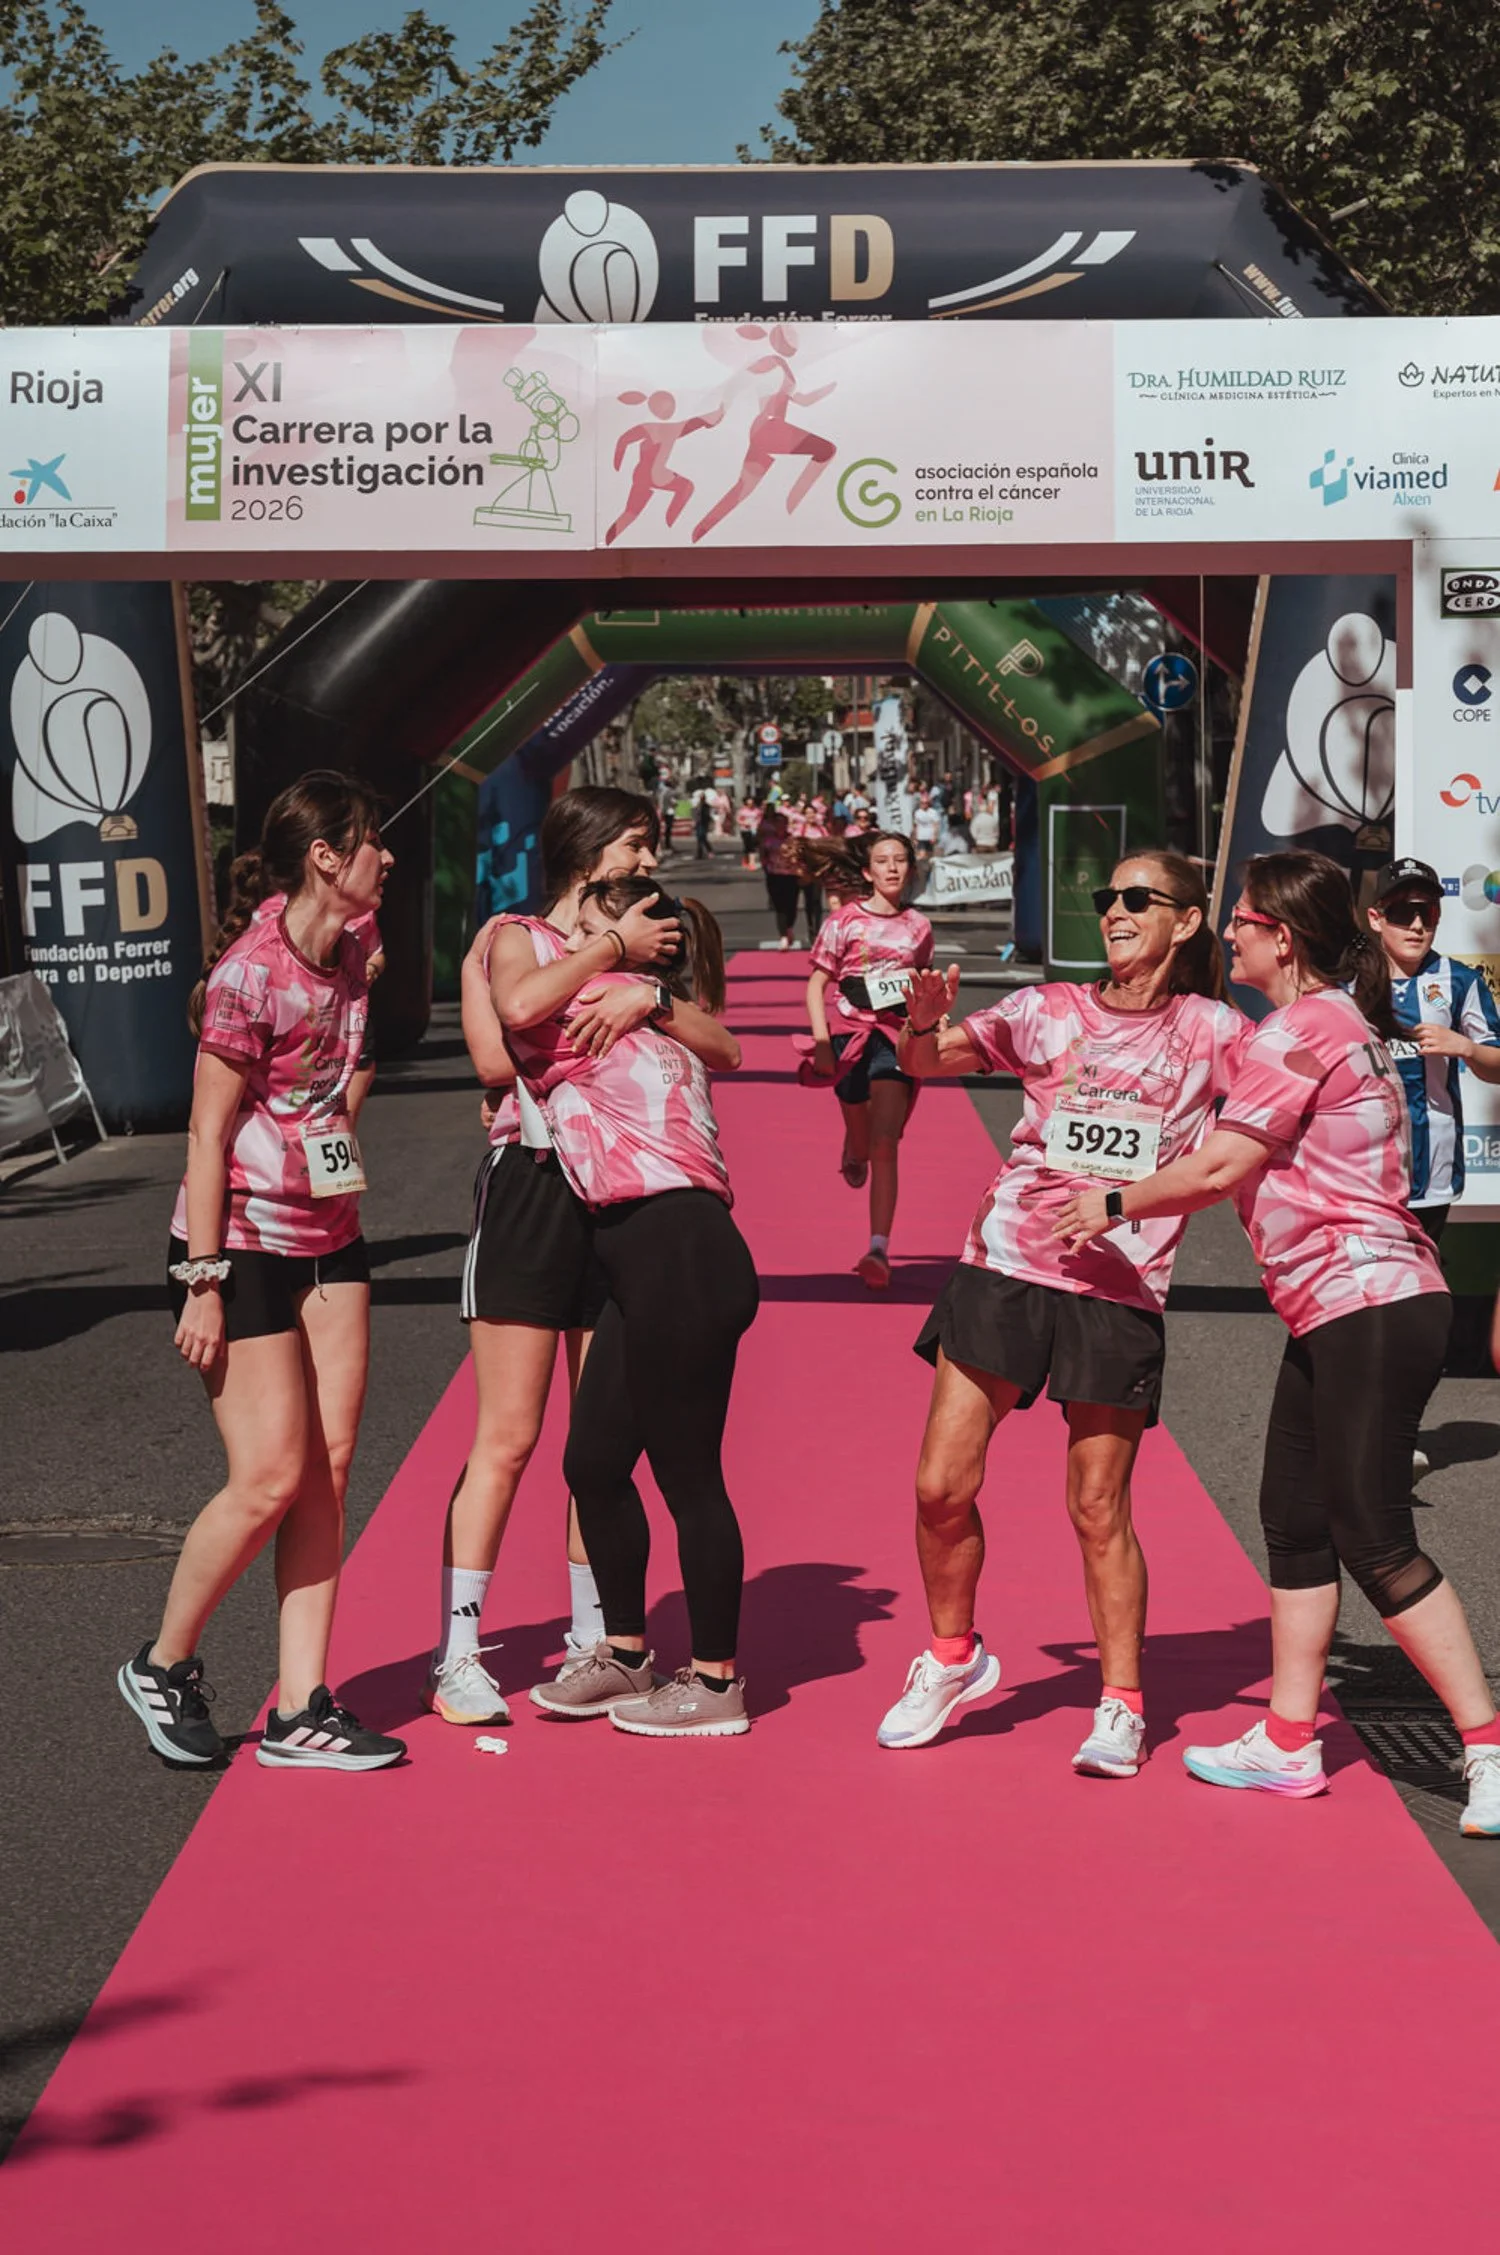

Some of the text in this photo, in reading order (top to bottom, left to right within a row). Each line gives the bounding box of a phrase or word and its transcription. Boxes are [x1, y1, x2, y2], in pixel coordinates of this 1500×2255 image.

[694, 214, 895, 303] FFD
[233, 361, 282, 403] XI
[1177, 367, 1293, 390] HUMILDAD
[1298, 369, 1346, 389] RUIZ
[10, 370, 104, 410] Rioja
[1160, 389, 1318, 401] CLÍNICA MEDICINA ESTÉTICA
[1433, 389, 1478, 399] Expertos
[1480, 390, 1492, 398] en
[183, 376, 224, 504] mujer
[232, 413, 493, 452] Carrera por la
[1392, 452, 1430, 465] Clínica
[232, 455, 484, 494] investigación
[915, 463, 1099, 482] asociación española
[1354, 462, 1448, 491] viamed
[915, 485, 1062, 501] contra el cáncer
[1135, 486, 1201, 495] UNIVERSIDAD
[1135, 497, 1216, 505] INTERNACIONAL
[231, 495, 304, 521] 2026
[915, 506, 1014, 526] en La Rioja
[1135, 507, 1194, 516] DE LA RIOJA
[1452, 578, 1496, 590] ONDA
[1454, 596, 1495, 609] CERO
[1453, 708, 1492, 722] COPE
[17, 857, 169, 938] FFD
[24, 938, 171, 963] Fundación Ferrer
[33, 959, 173, 985] ara el Deporte
[1077, 1082, 1140, 1103] Carrera
[1065, 1120, 1141, 1160] 5923
